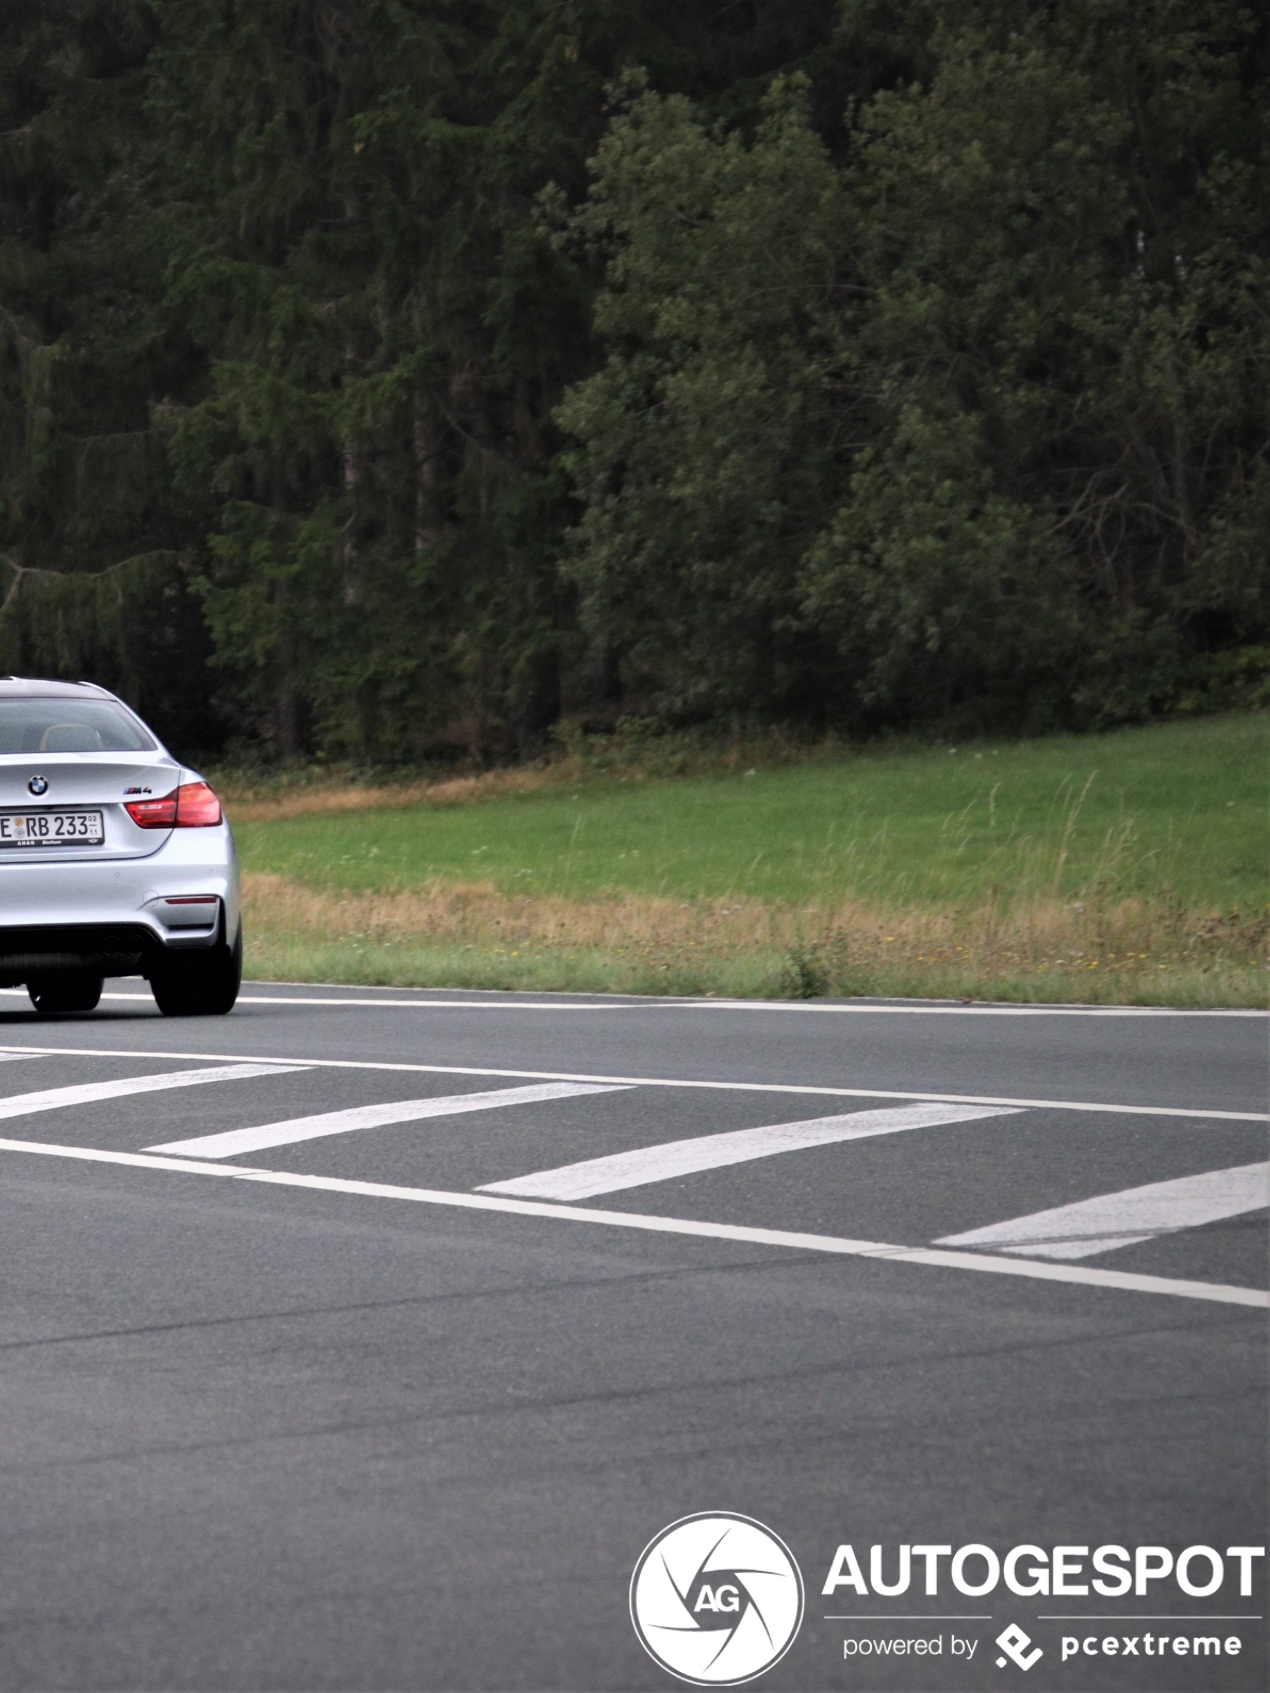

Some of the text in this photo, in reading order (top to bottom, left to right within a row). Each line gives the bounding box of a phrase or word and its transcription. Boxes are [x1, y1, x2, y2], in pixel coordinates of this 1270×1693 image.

[128, 786, 152, 795] M4
[25, 816, 50, 837] RB
[54, 815, 89, 836] 233
